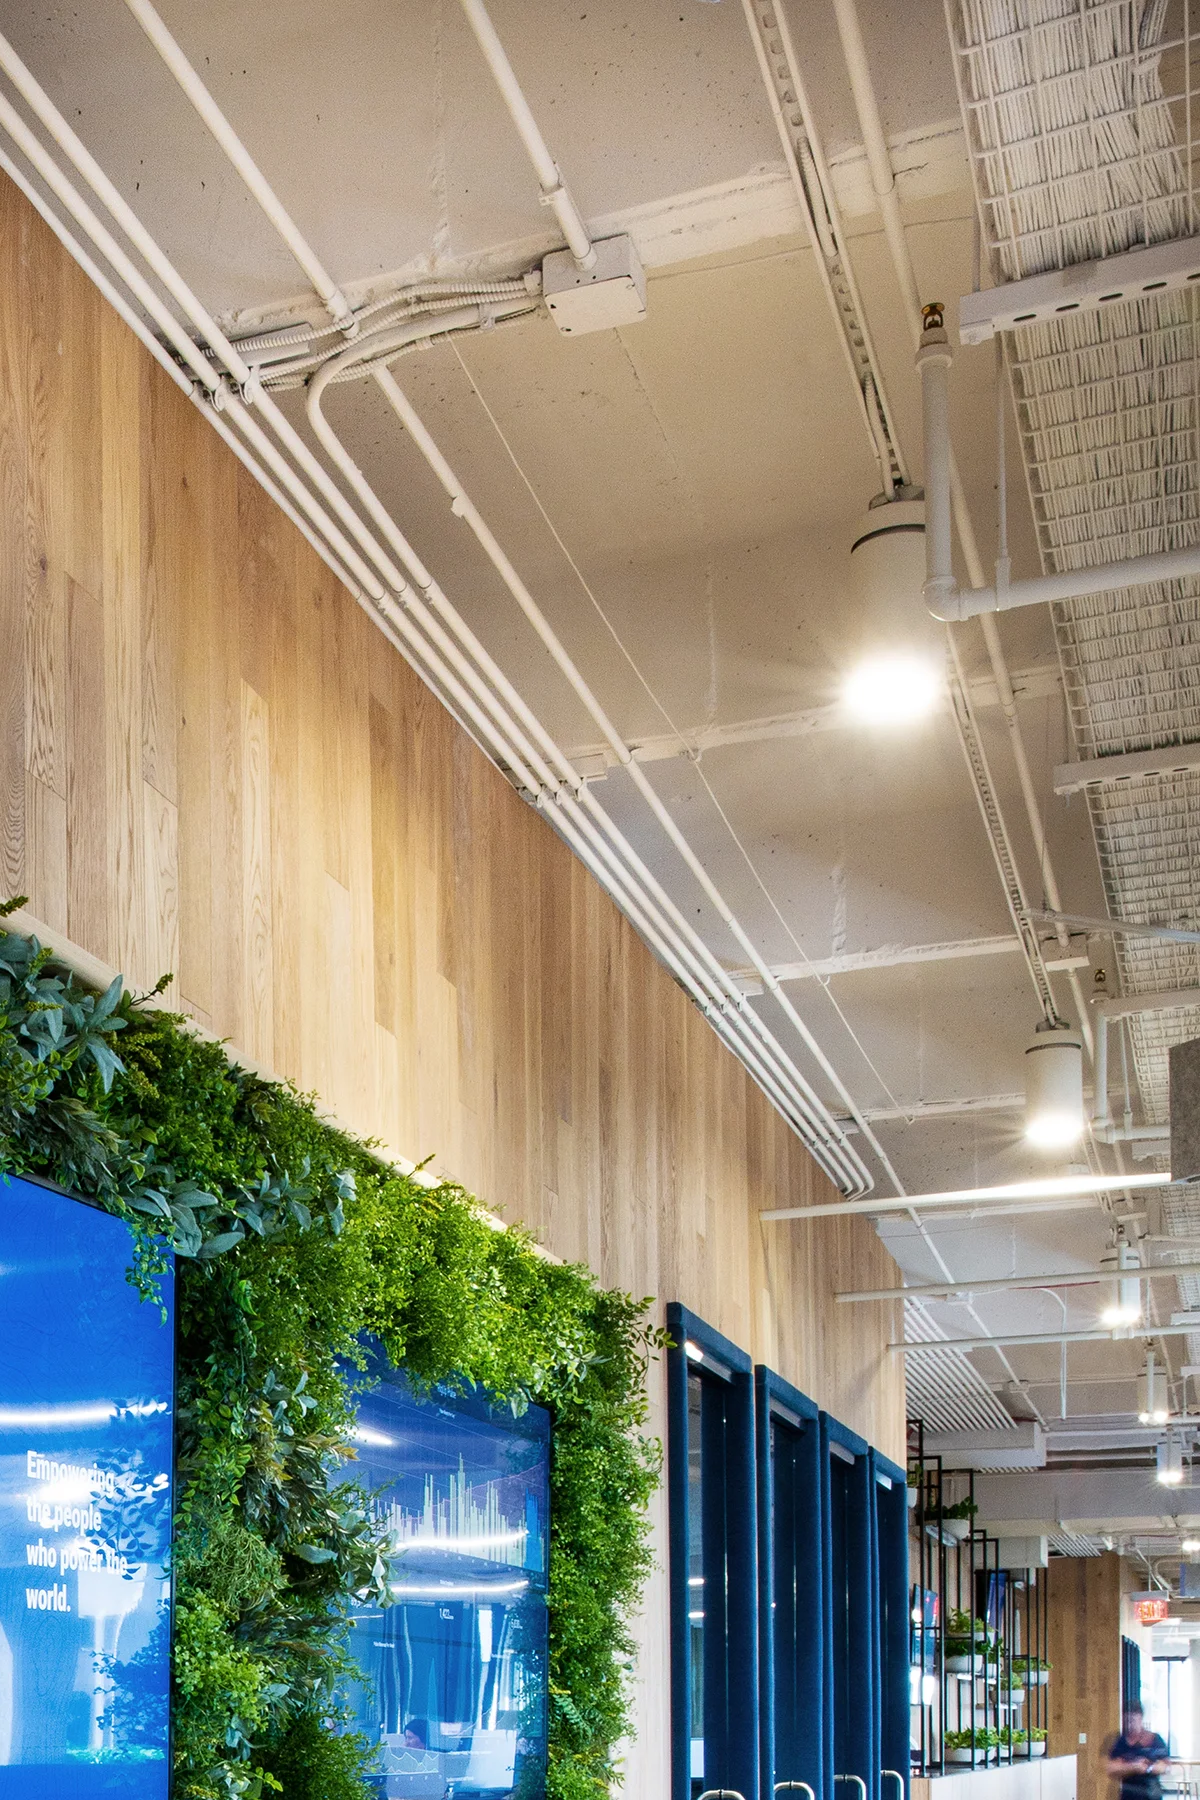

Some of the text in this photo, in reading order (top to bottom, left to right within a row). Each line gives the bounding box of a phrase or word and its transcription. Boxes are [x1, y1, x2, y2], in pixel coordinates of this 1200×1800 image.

[26, 1450, 116, 1498] Empowering
[26, 1494, 102, 1537] the people
[26, 1538, 128, 1576] who power the
[25, 1582, 71, 1612] world.
